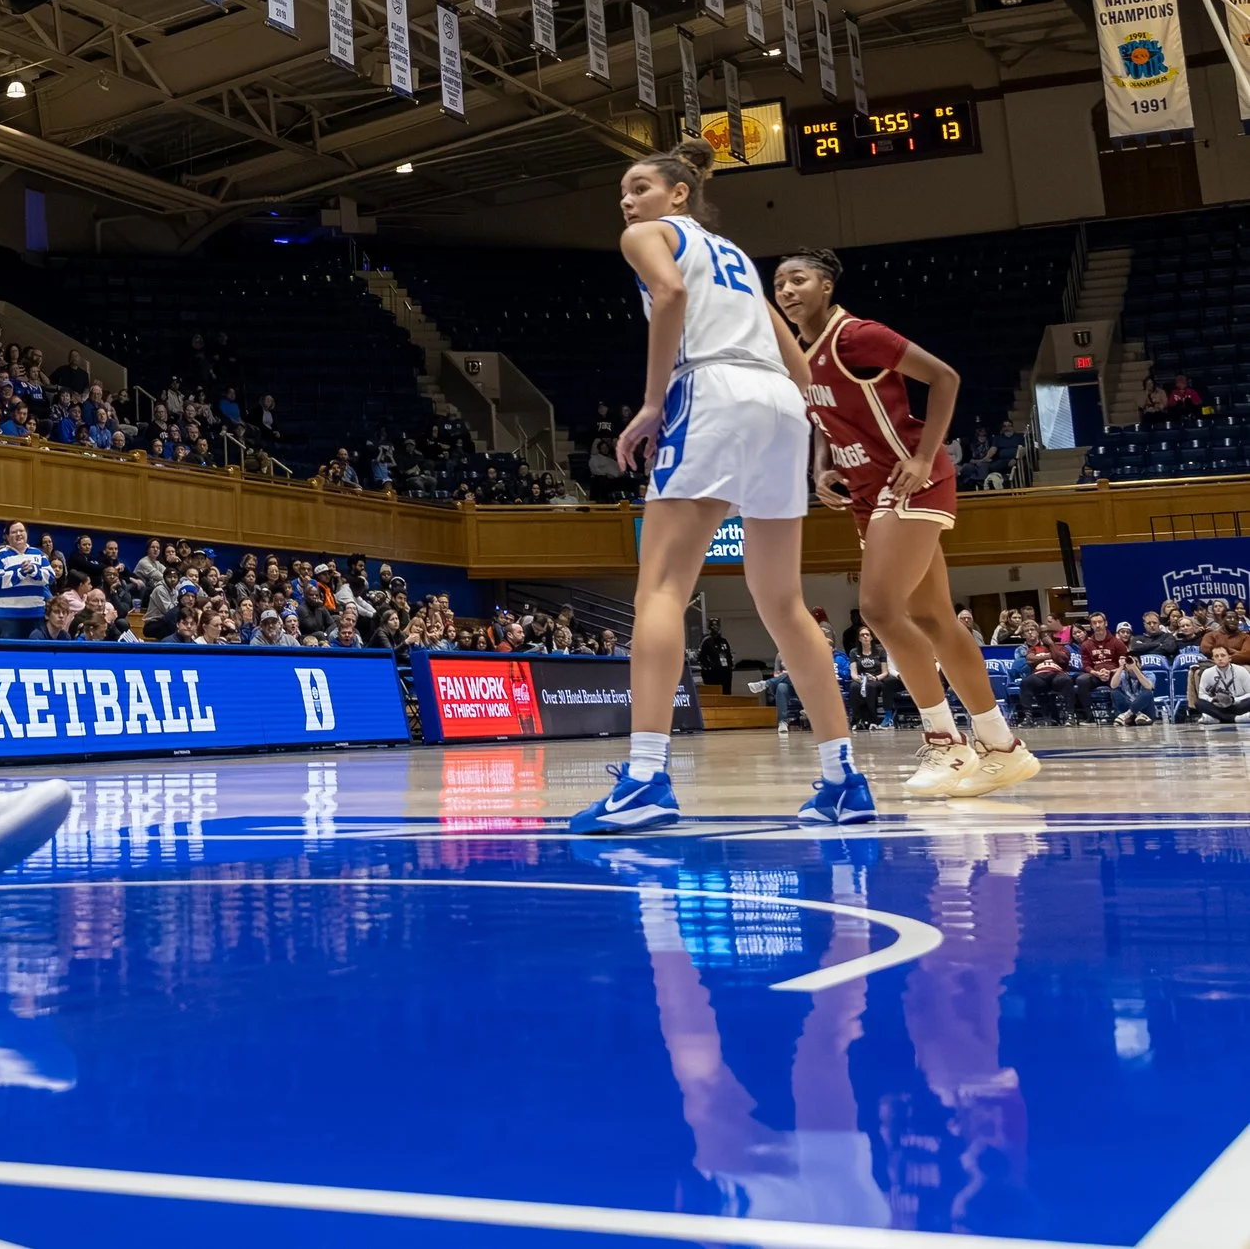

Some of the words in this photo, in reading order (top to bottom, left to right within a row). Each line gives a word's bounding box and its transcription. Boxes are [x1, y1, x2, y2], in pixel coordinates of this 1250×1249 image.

[1099, 2, 1174, 26] CHAMPIONS
[1129, 32, 1147, 40] 1991
[935, 106, 954, 117] BC
[1131, 97, 1168, 114] 1991
[803, 122, 838, 135] DUKE
[869, 112, 909, 132] 7:55
[941, 121, 960, 140] 13
[816, 137, 840, 157] 29
[871, 142, 877, 155] 1
[908, 138, 915, 150] 1
[704, 236, 755, 297] 12
[1172, 582, 1246, 603] SISTERHOOD
[437, 676, 467, 701] FAN
[467, 676, 509, 700] WORK
[542, 688, 558, 705] Over
[558, 689, 566, 705] 30
[566, 688, 584, 705] Hotel
[584, 688, 603, 705] Brands
[603, 688, 611, 705] for
[612, 689, 629, 706] Every
[443, 704, 451, 718] IS
[451, 703, 487, 719] THIRSTY
[486, 703, 512, 718] WORK
